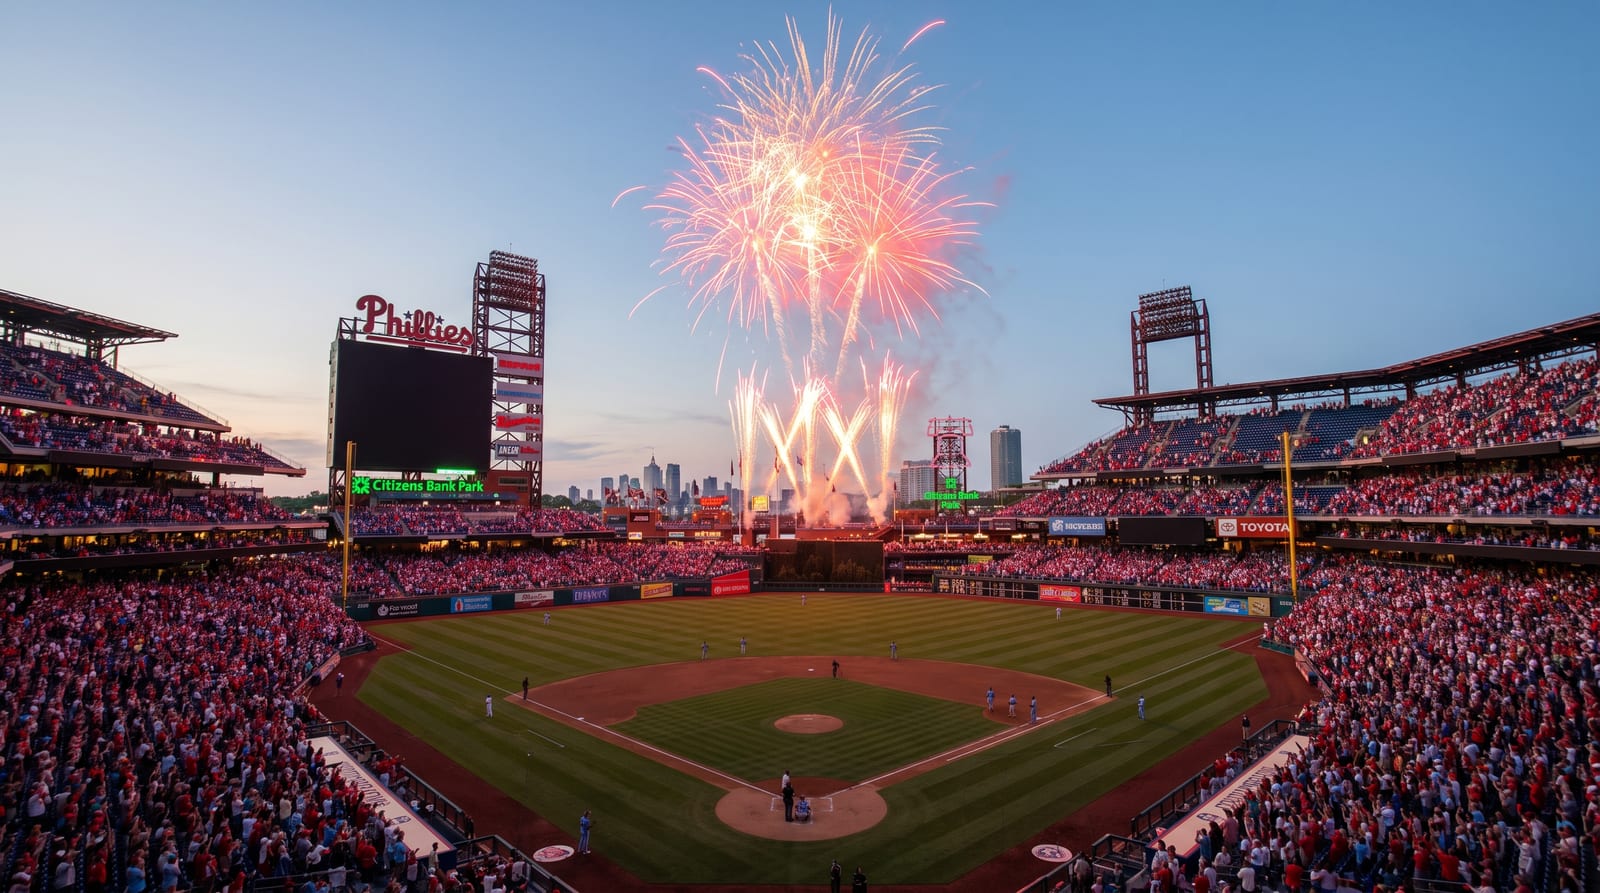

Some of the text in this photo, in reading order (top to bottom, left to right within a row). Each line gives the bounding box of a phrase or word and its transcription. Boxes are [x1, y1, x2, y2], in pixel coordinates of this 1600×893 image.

[356, 294, 474, 346] Phillies
[372, 479, 484, 492] Citizens Bank Park
[958, 490, 980, 500] Bank
[1240, 522, 1290, 532] TOYOTA
